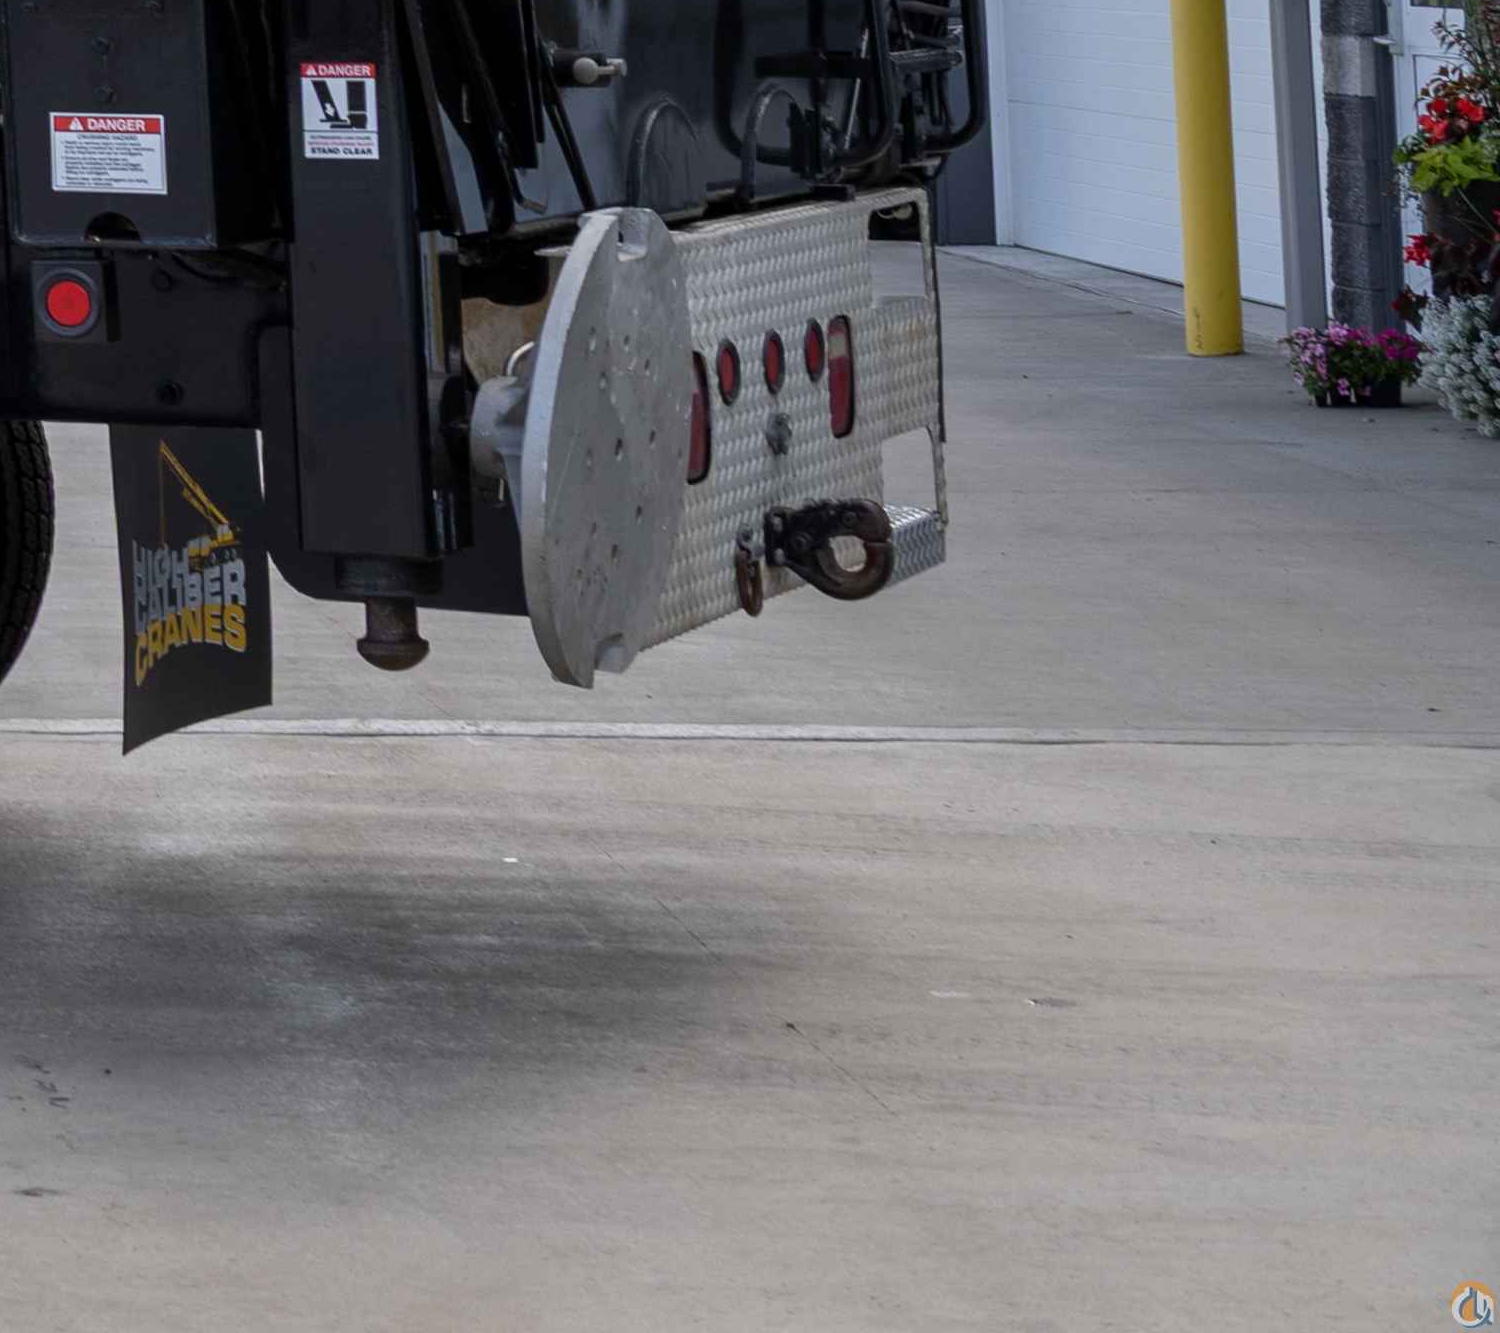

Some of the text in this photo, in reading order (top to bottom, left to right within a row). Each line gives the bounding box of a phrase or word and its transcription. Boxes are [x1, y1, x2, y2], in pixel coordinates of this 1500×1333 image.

[318, 64, 371, 77] DANGER
[88, 117, 146, 132] DANGER
[132, 539, 188, 590] HIGH
[134, 558, 247, 636] CALIBER
[135, 603, 247, 686] CRANES
